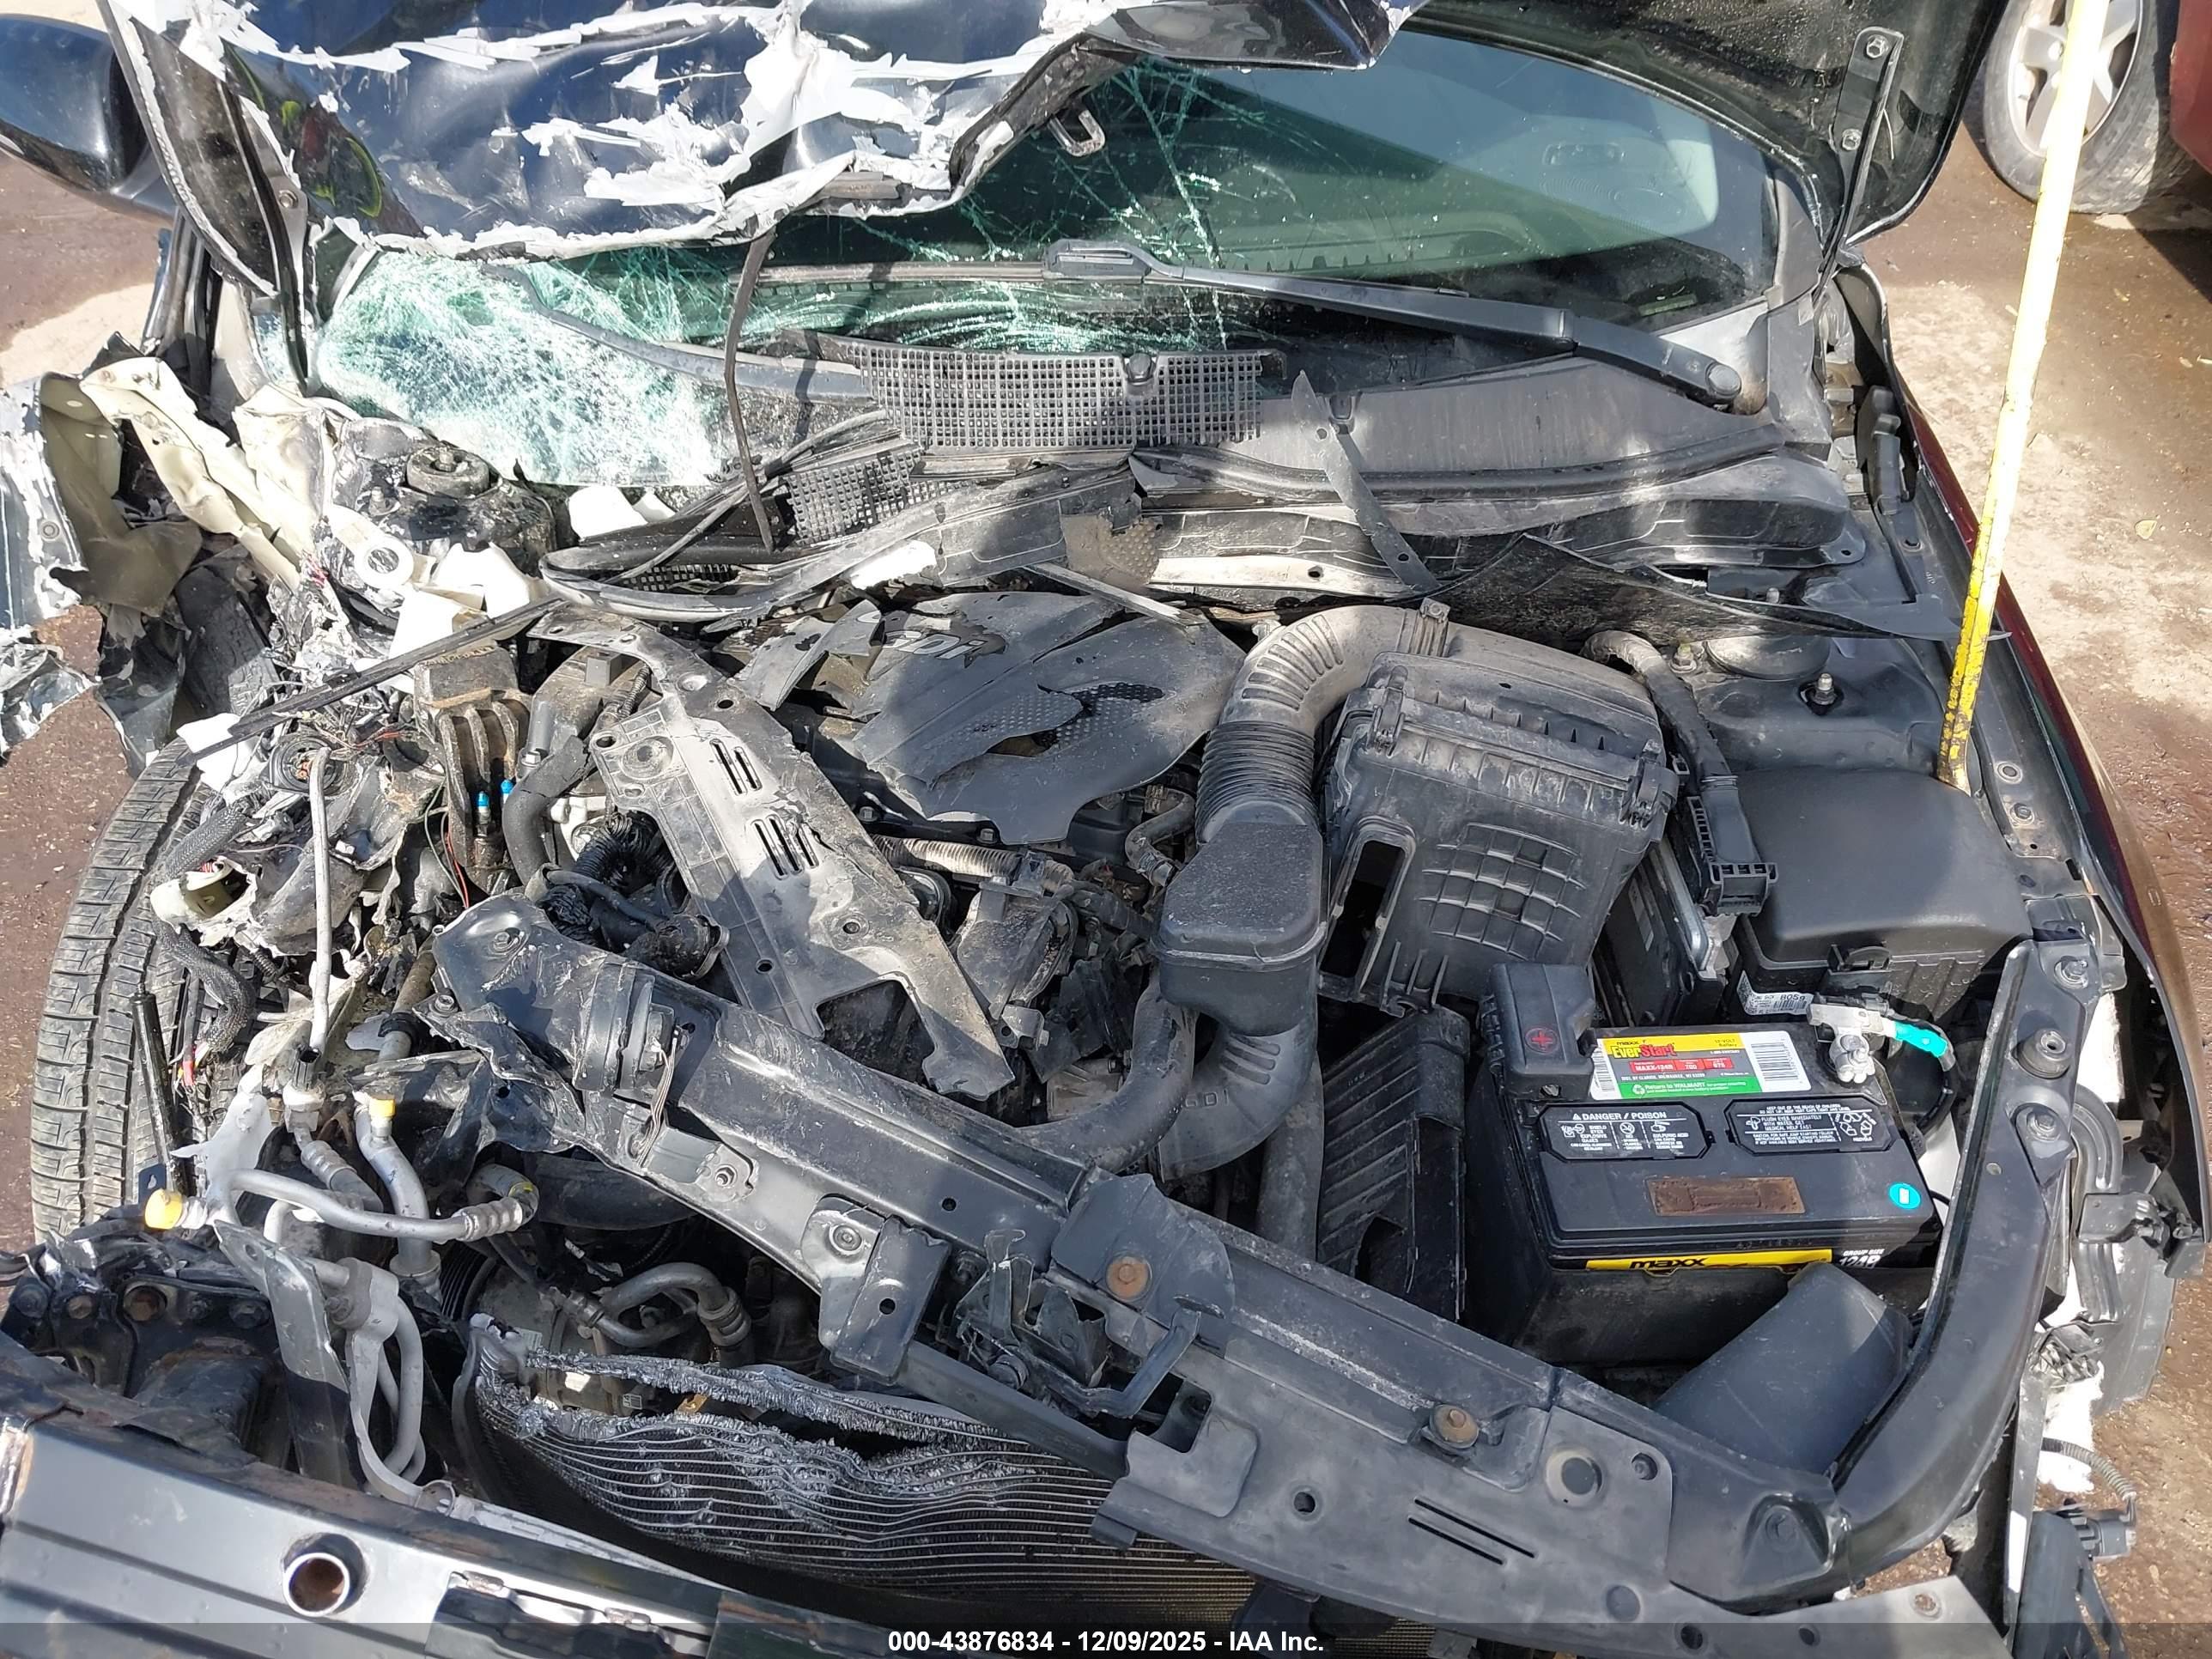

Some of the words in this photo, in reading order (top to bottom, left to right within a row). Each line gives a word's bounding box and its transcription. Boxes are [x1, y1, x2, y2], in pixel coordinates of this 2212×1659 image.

[1611, 1043, 1677, 1059] EverStart
[1631, 1111, 1668, 1120] POISON
[1629, 1257, 1708, 1269] maxx
